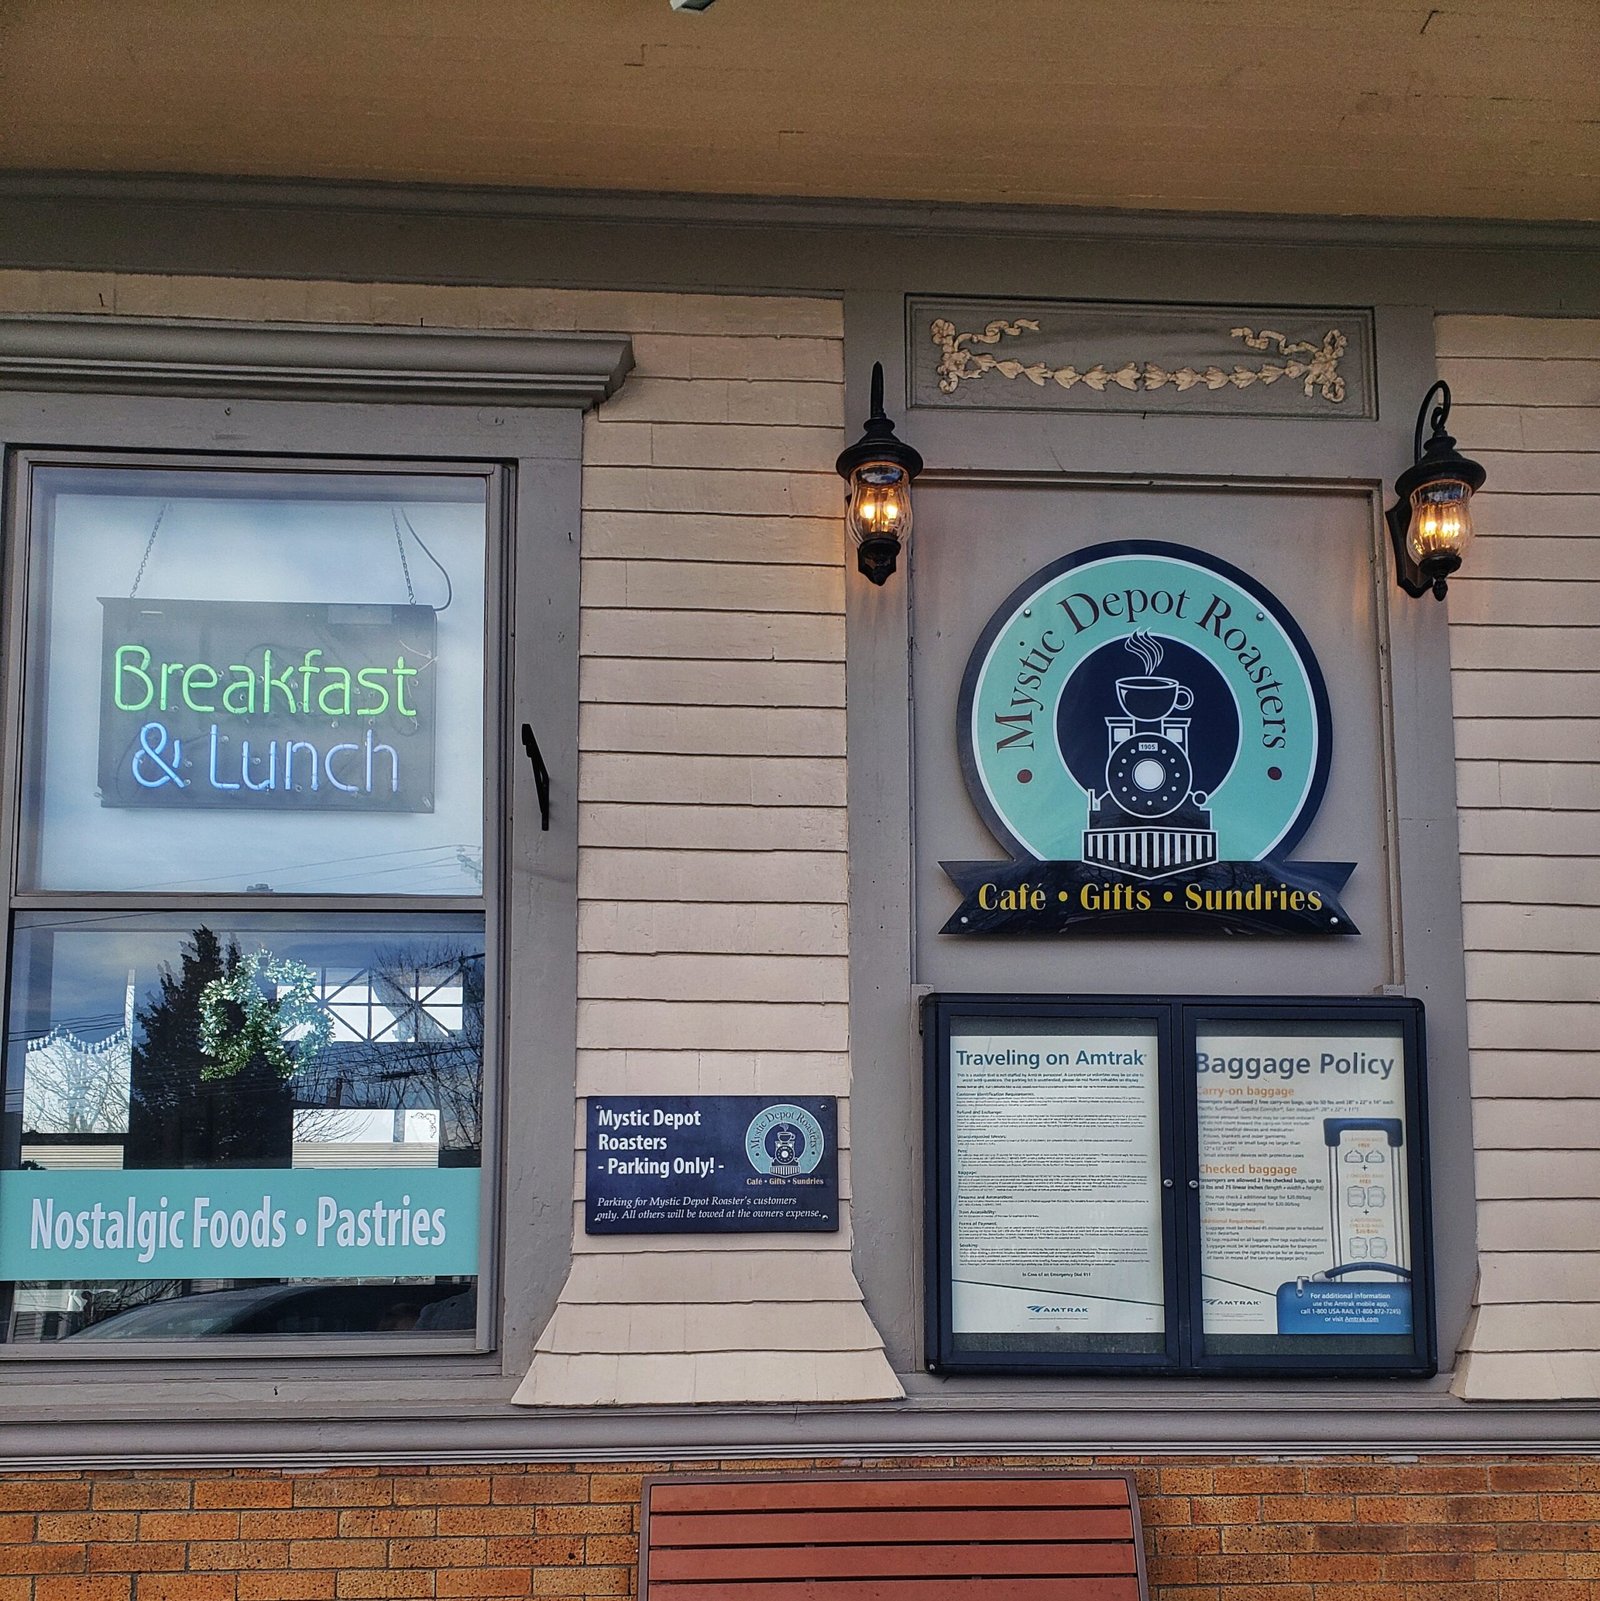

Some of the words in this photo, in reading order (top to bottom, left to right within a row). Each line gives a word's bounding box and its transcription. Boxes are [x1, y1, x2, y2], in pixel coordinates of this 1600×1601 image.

[114, 645, 417, 716] Breakfast
[994, 630, 1065, 754] Mystic
[1057, 589, 1190, 634] Depot
[1195, 593, 1287, 750] Roasters
[132, 722, 184, 788] &
[210, 724, 399, 792] Lunch
[978, 882, 1047, 911] Café
[1080, 882, 1152, 911] Gifts
[1185, 882, 1323, 912] Sundries
[956, 1050, 1040, 1069] Traveling
[1046, 1055, 1070, 1066] on
[1076, 1050, 1144, 1066] Amtrak
[1197, 1053, 1310, 1079] Baggage
[1320, 1052, 1394, 1080] Policy
[1247, 1086, 1295, 1098] baggage
[598, 1110, 650, 1130] Mystic
[654, 1110, 701, 1130] Depot
[750, 1120, 767, 1148] Mystic
[764, 1112, 794, 1122] Depot
[797, 1112, 816, 1148] Roasters
[598, 1134, 667, 1150] Roasters
[608, 1158, 670, 1178] Parking
[674, 1157, 714, 1178] Only!
[1200, 1164, 1245, 1174] Checked
[1249, 1164, 1297, 1176] baggage
[598, 1198, 632, 1209] Parking
[633, 1197, 648, 1208] for
[650, 1197, 680, 1208] Mystic
[683, 1196, 708, 1208] Depot
[712, 1196, 752, 1206] Roaster's
[754, 1196, 797, 1205] customers
[597, 1210, 620, 1222] only.
[622, 1210, 636, 1218] All
[638, 1210, 666, 1218] others
[668, 1209, 684, 1218] will
[686, 1209, 696, 1218] be
[698, 1209, 724, 1218] towed
[726, 1209, 735, 1218] at
[738, 1208, 750, 1218] the
[786, 1210, 822, 1220] expense.
[31, 1196, 185, 1263] Nostalgic
[193, 1196, 286, 1248] Foods
[317, 1195, 446, 1246] Pastries
